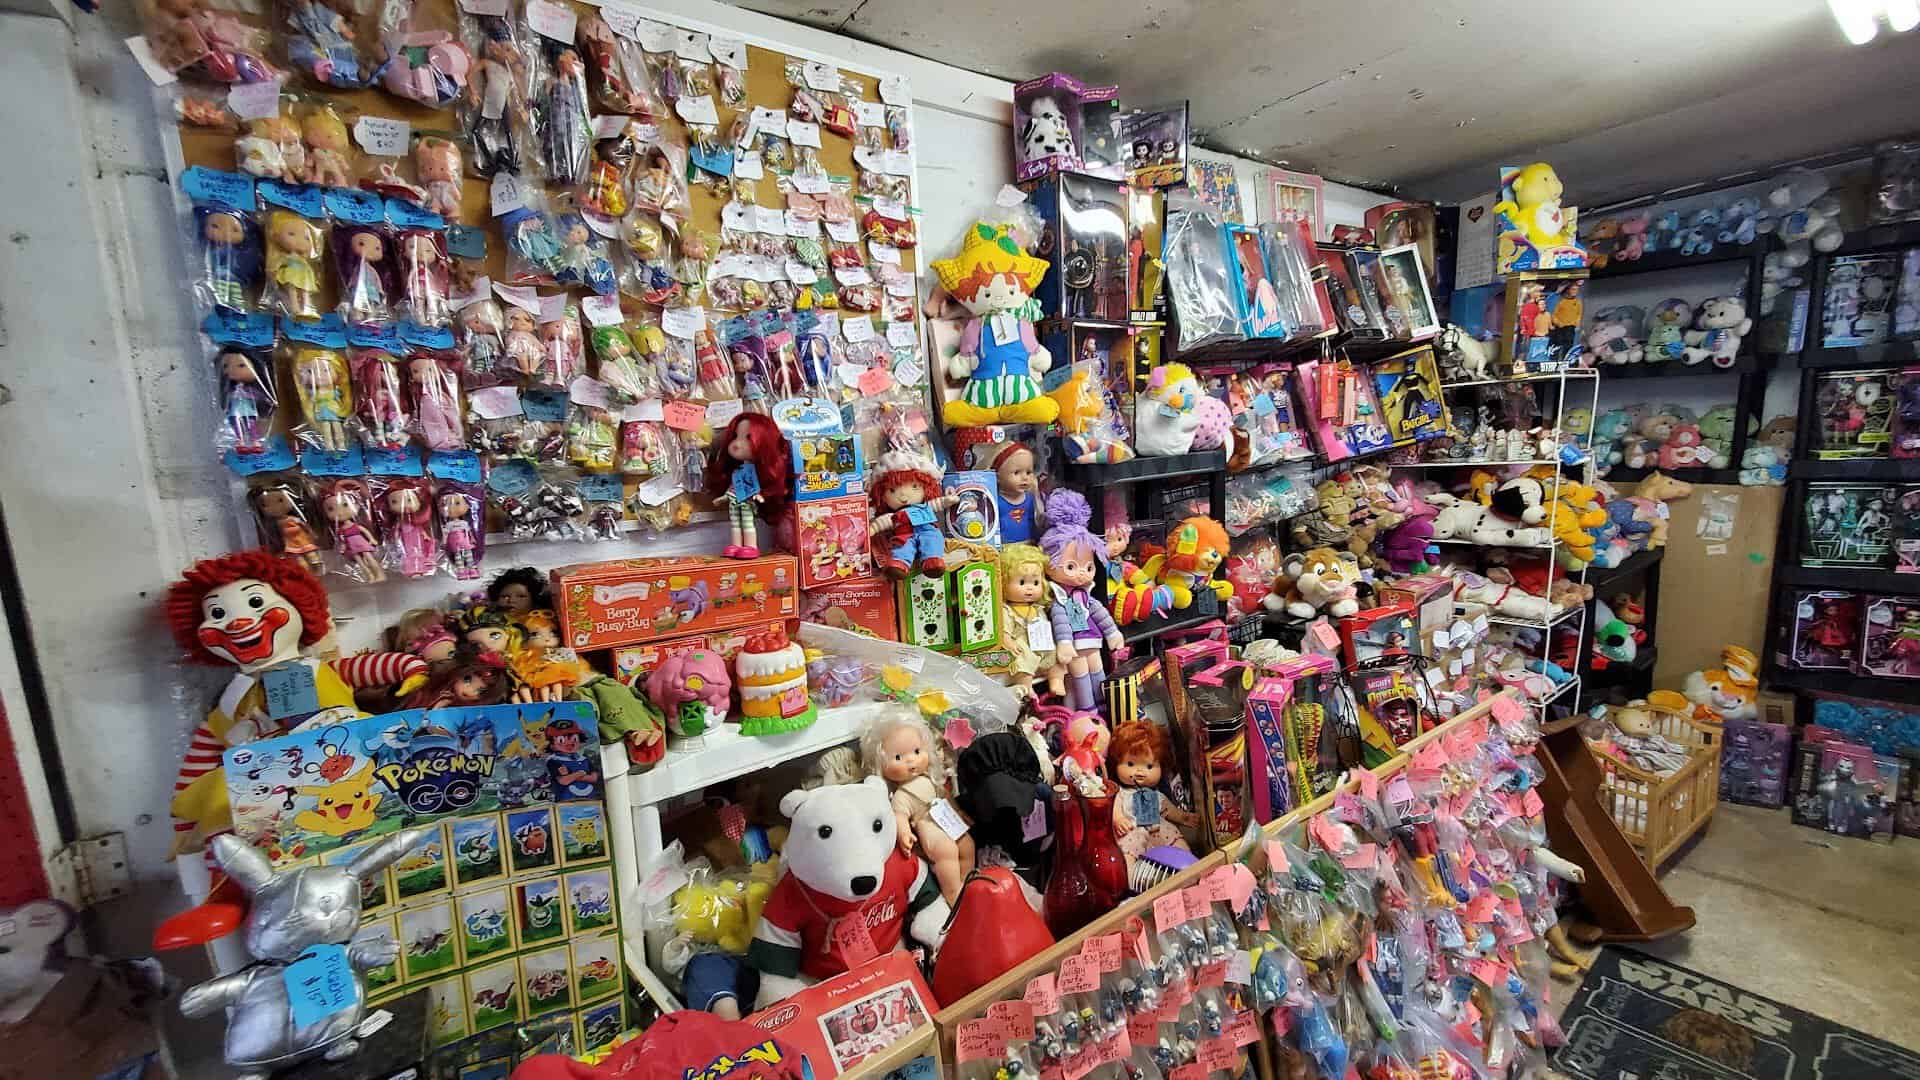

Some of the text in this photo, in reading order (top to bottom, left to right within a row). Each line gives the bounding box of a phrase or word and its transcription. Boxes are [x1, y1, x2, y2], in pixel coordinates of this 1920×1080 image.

[596, 617, 650, 634] Busy-Bug
[604, 606, 640, 620] Berry
[408, 779, 480, 814] GO
[1619, 958, 1787, 1024] STAR
[1619, 962, 1792, 1037] WARS
